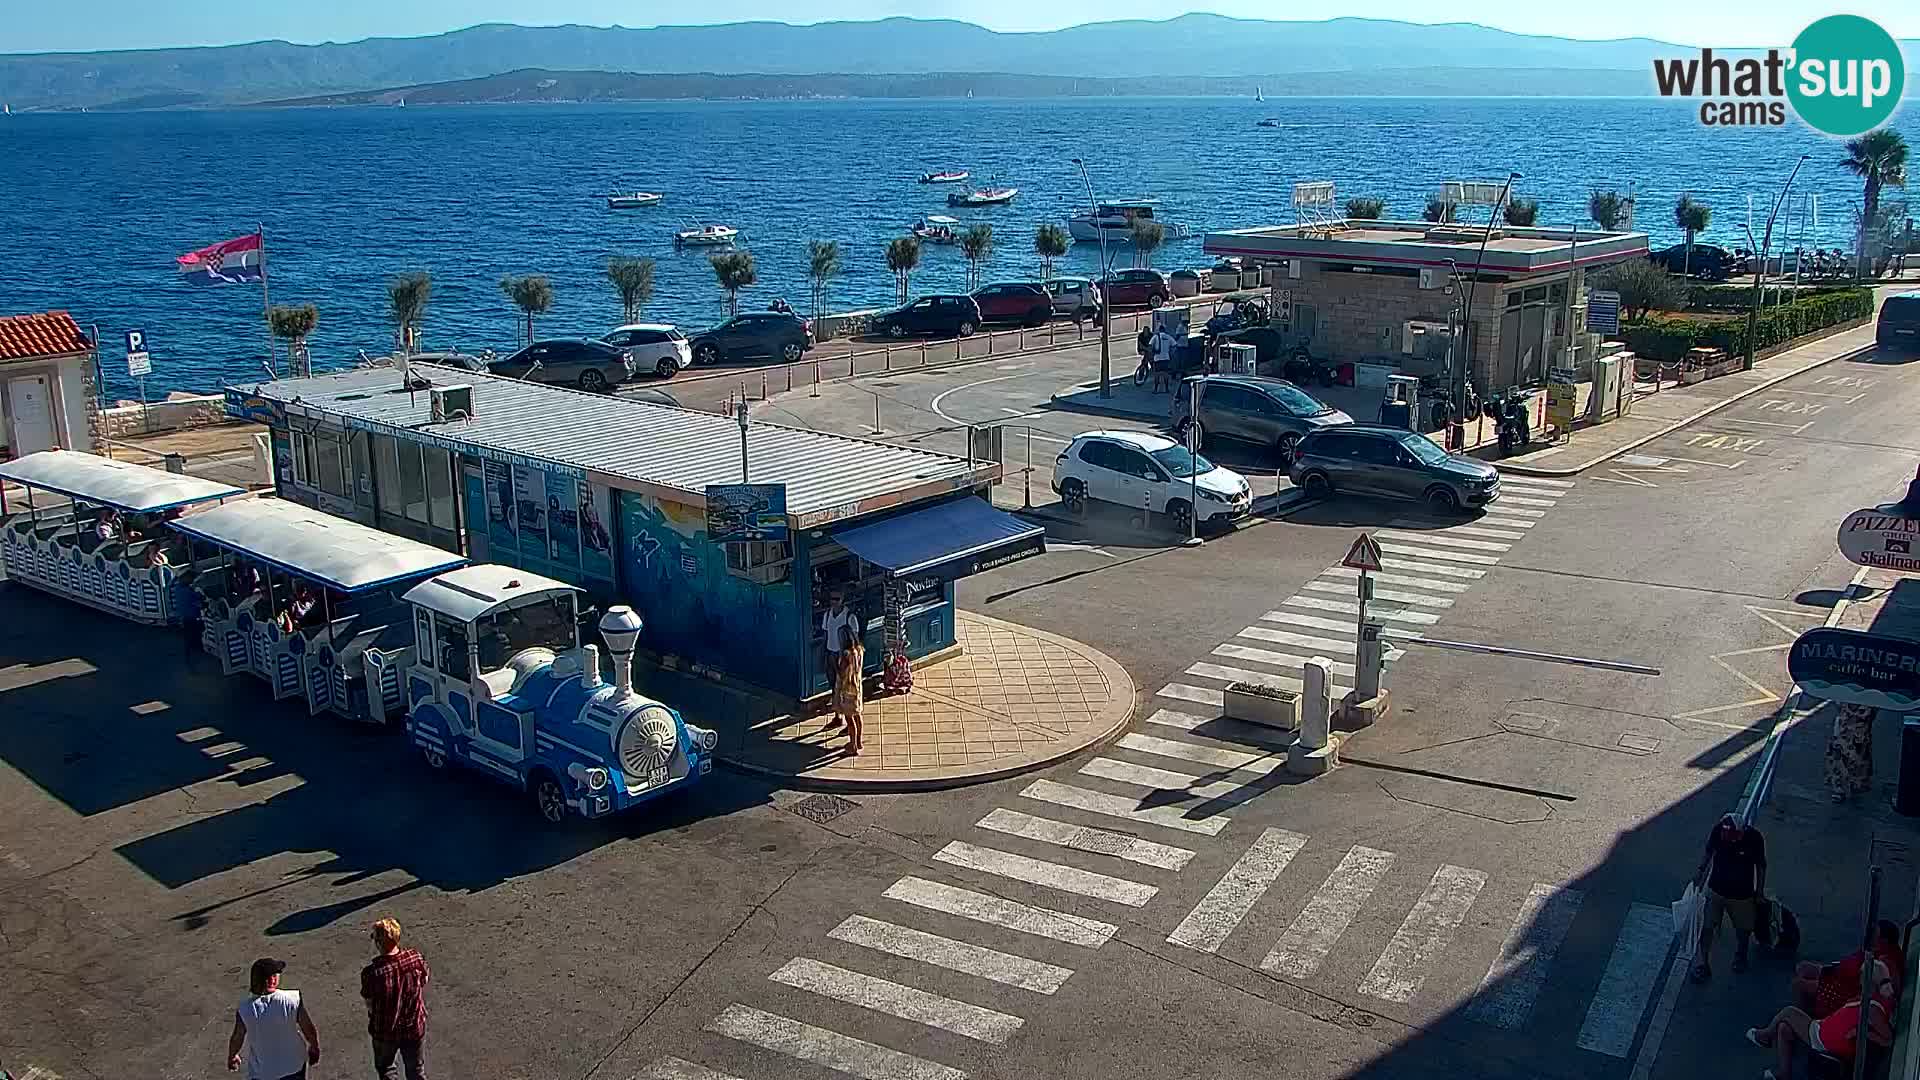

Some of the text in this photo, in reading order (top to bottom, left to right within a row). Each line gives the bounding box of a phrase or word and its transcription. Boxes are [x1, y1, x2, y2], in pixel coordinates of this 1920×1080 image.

[129, 332, 142, 351] P
[1815, 375, 1881, 390] TAXI
[1758, 399, 1829, 416] TAXI
[1684, 433, 1766, 452] TAXI
[478, 447, 493, 460] BUS
[493, 451, 526, 466] STATION
[528, 458, 554, 472] TICKET
[555, 464, 581, 479] OFFICE
[1871, 666, 1897, 681] bar
